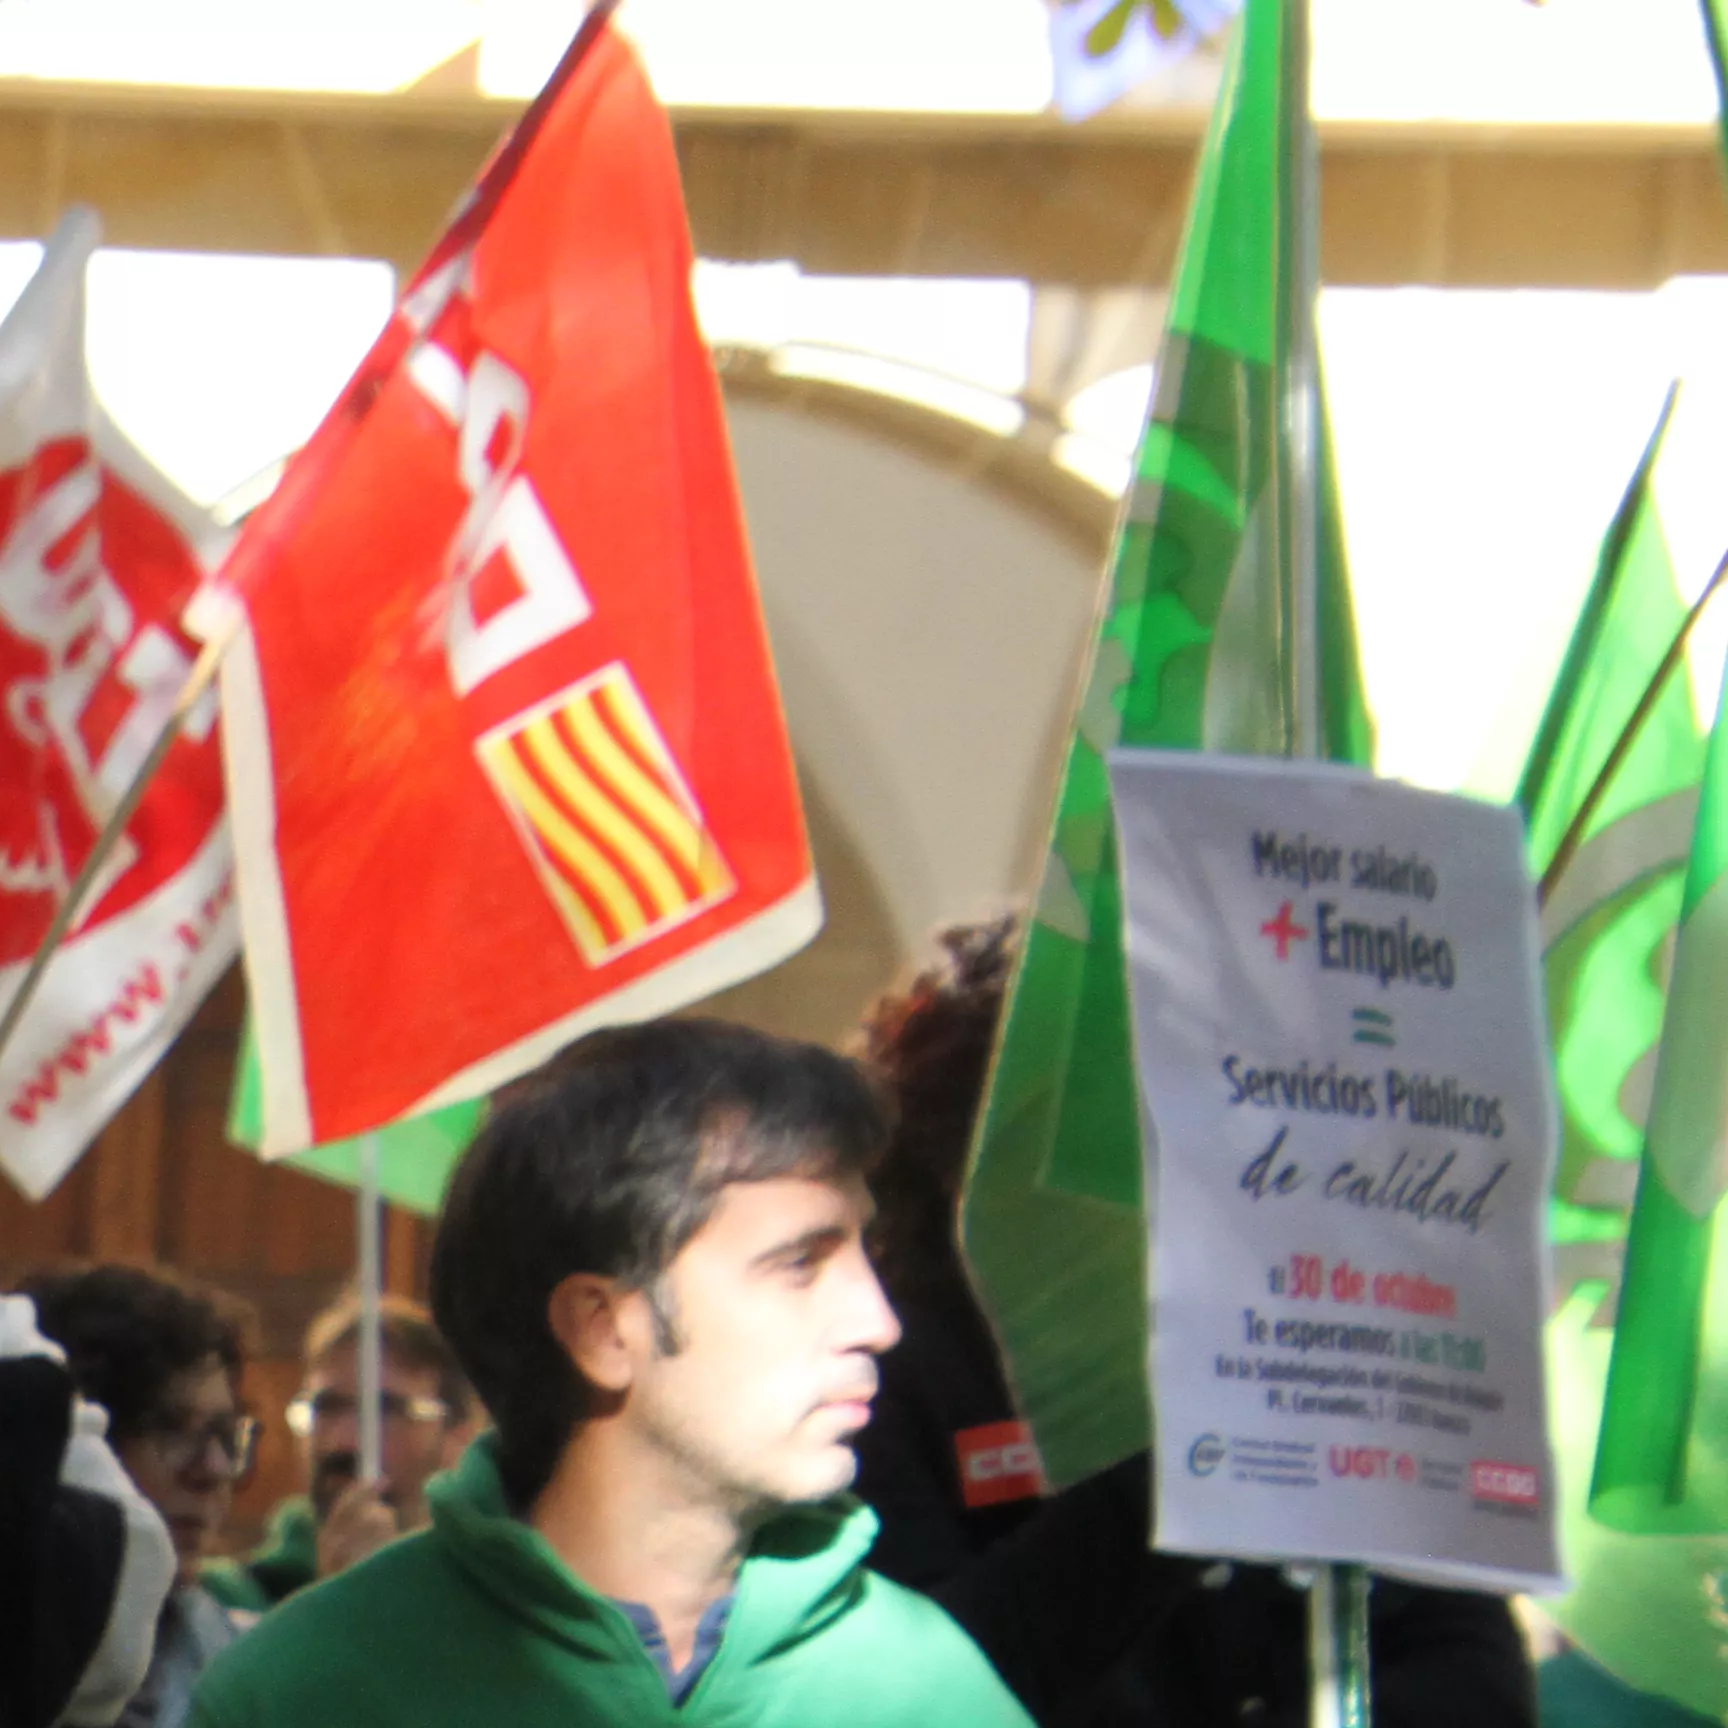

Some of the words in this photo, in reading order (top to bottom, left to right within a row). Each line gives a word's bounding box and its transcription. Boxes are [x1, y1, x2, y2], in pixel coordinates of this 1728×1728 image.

[1250, 828, 1342, 890] Mejor
[1349, 844, 1438, 904] salario
[1316, 901, 1456, 991] Empleo
[1221, 1054, 1378, 1119] Servicios
[1385, 1069, 1506, 1139] Públicos
[1238, 1125, 1304, 1202] de
[1322, 1150, 1512, 1235] calidad
[1288, 1253, 1324, 1301] 30
[1329, 1258, 1366, 1306] de
[1372, 1270, 1458, 1321] octubre
[1243, 1307, 1268, 1346] Te
[1274, 1319, 1395, 1357] esperamos
[1328, 1444, 1391, 1481] UGT
